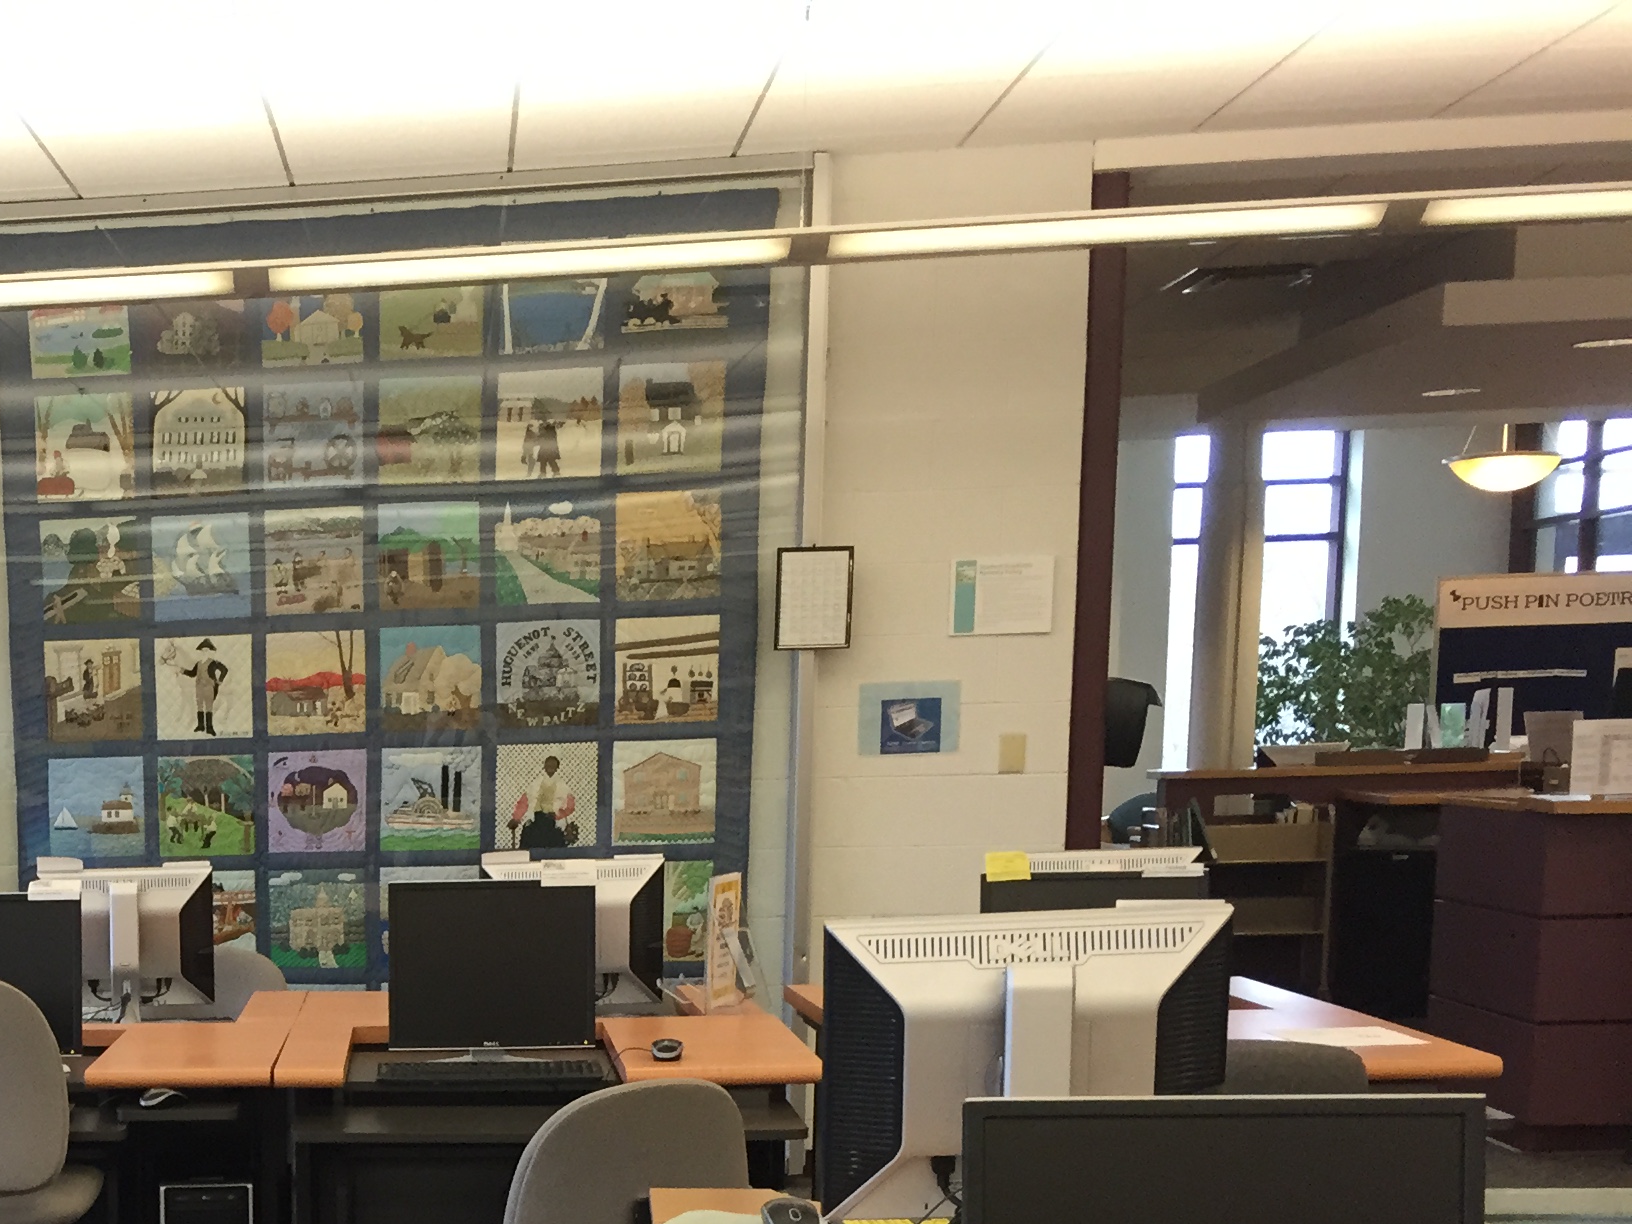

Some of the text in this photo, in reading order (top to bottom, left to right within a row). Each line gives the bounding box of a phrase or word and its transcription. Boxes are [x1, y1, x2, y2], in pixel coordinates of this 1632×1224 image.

[1461, 594, 1519, 610] PUSH
[1525, 593, 1560, 609] PIN
[501, 626, 597, 687] HUGUENOT STREET
[508, 701, 586, 726] NEW PALTZ
